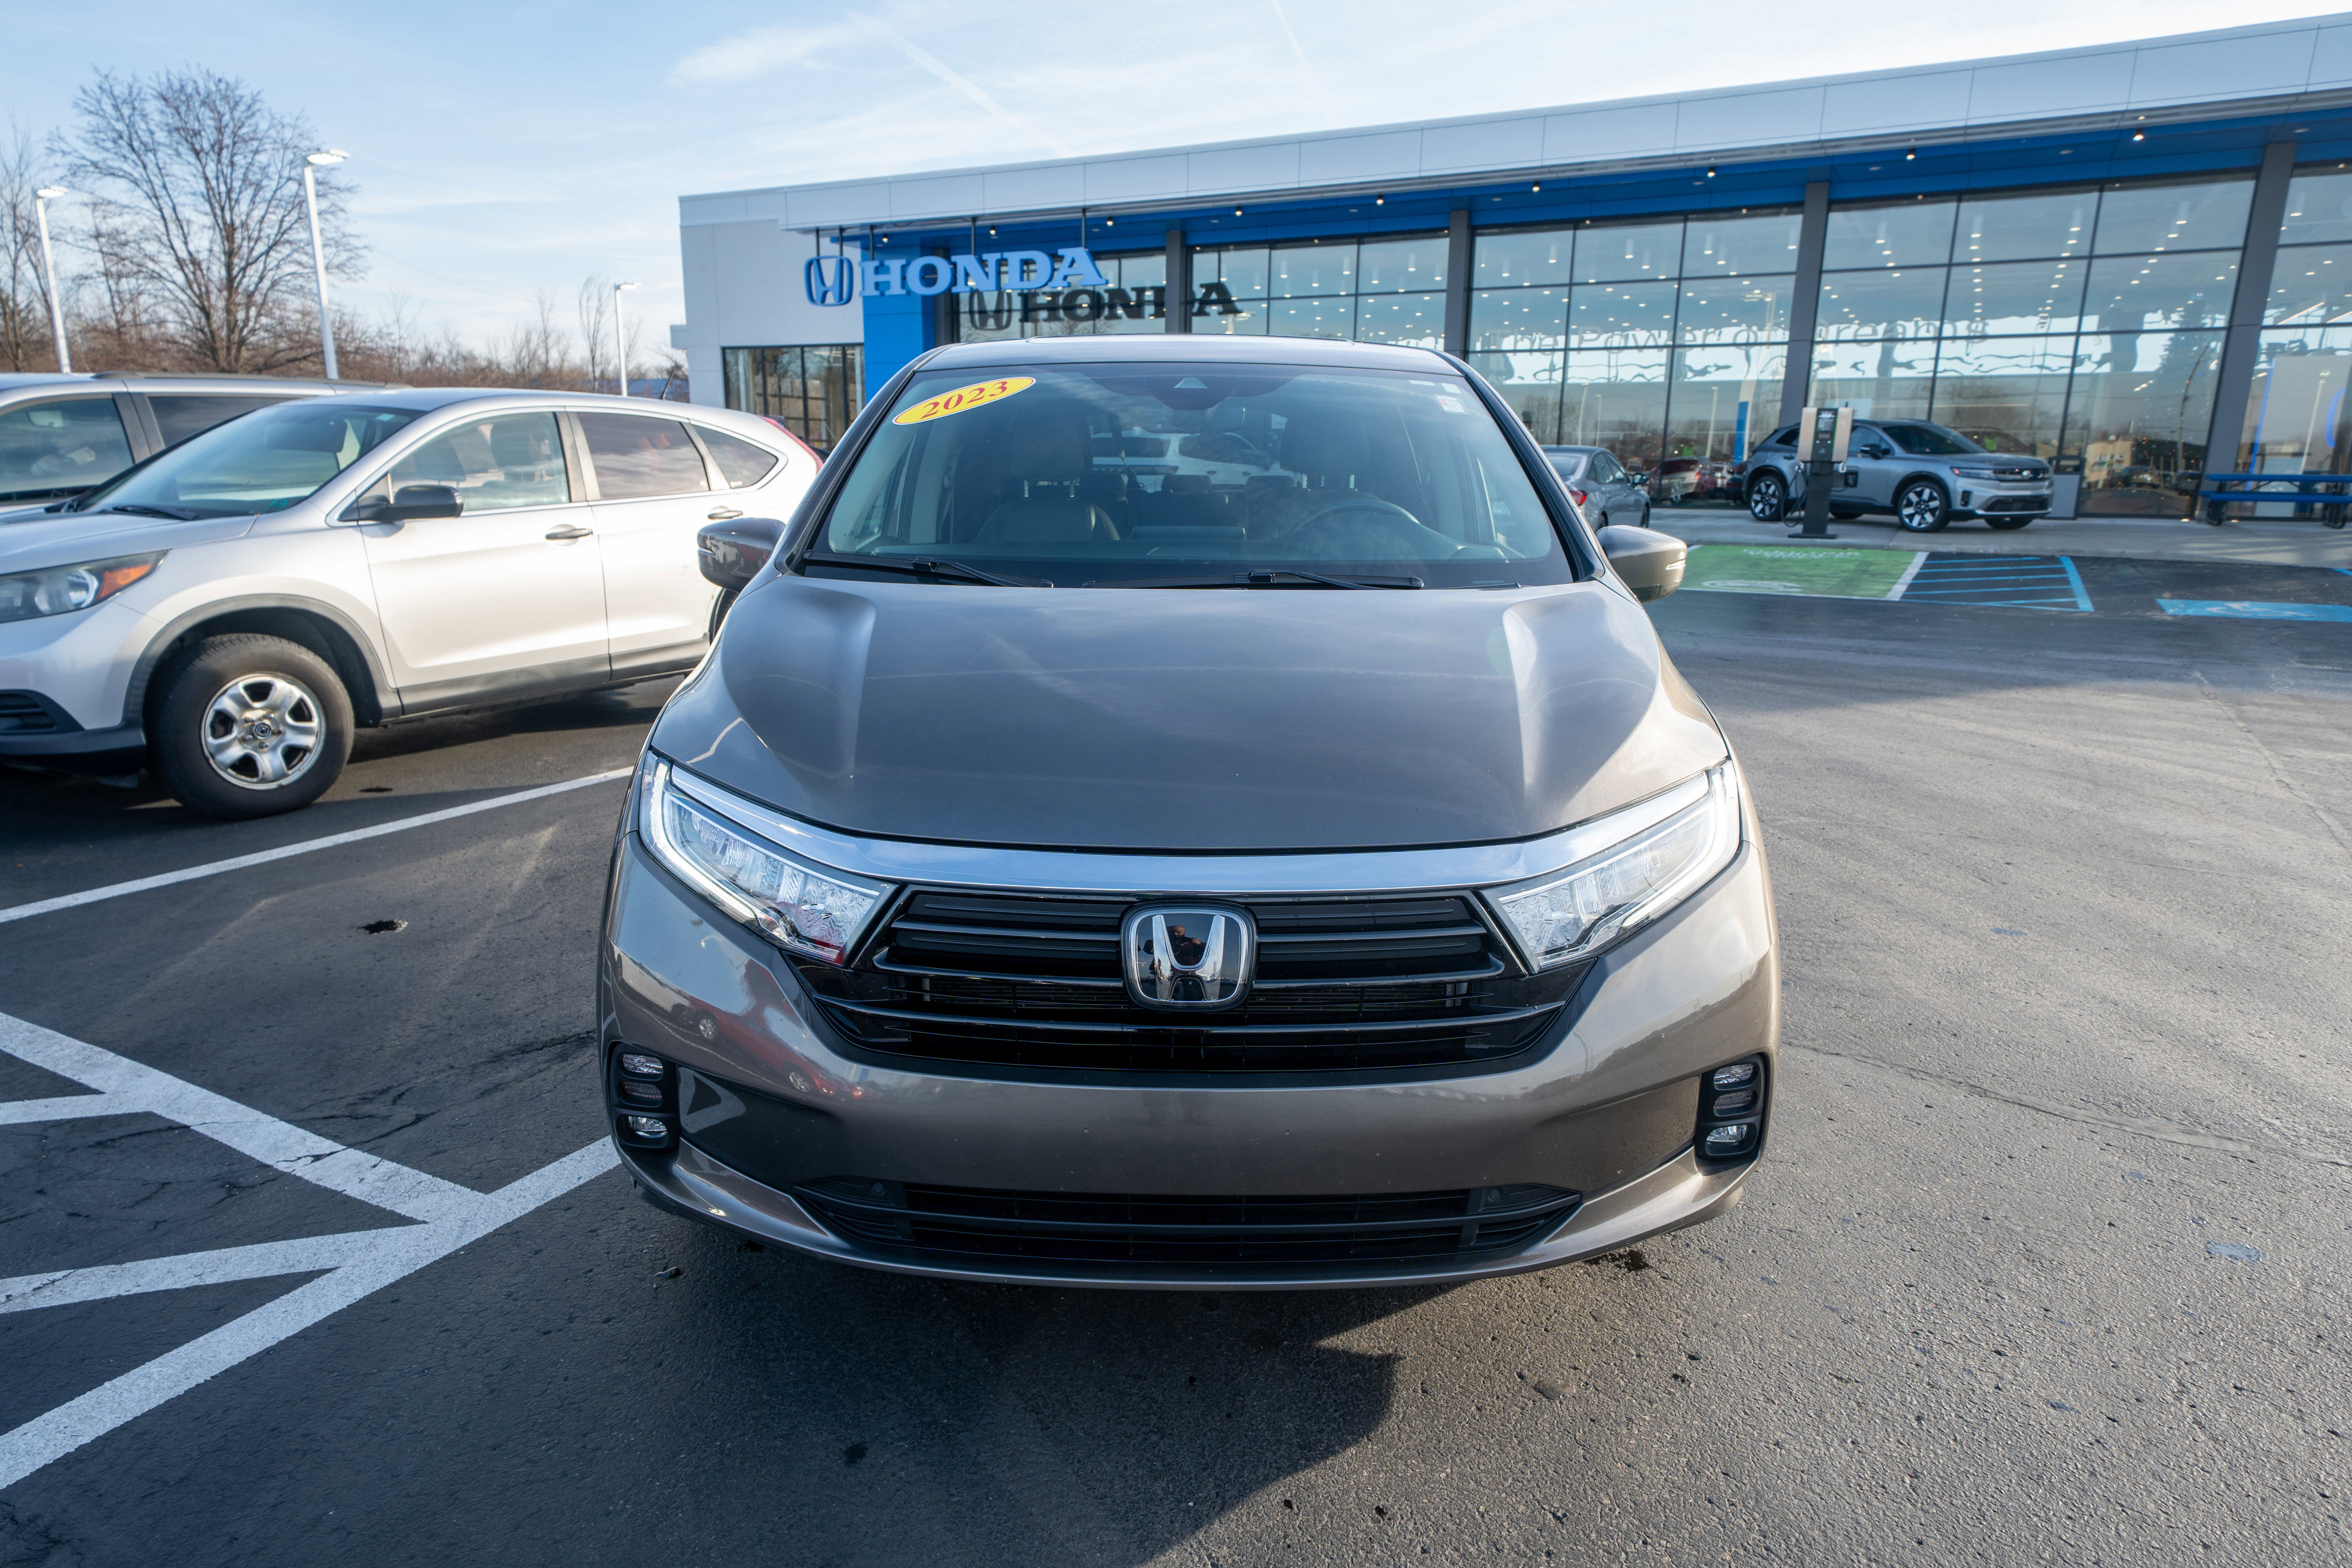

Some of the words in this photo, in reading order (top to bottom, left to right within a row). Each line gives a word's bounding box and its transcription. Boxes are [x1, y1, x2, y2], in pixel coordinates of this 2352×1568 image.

[858, 247, 1108, 296] HONDA
[1577, 325, 1715, 354] Power
[919, 381, 1008, 419] 2023
